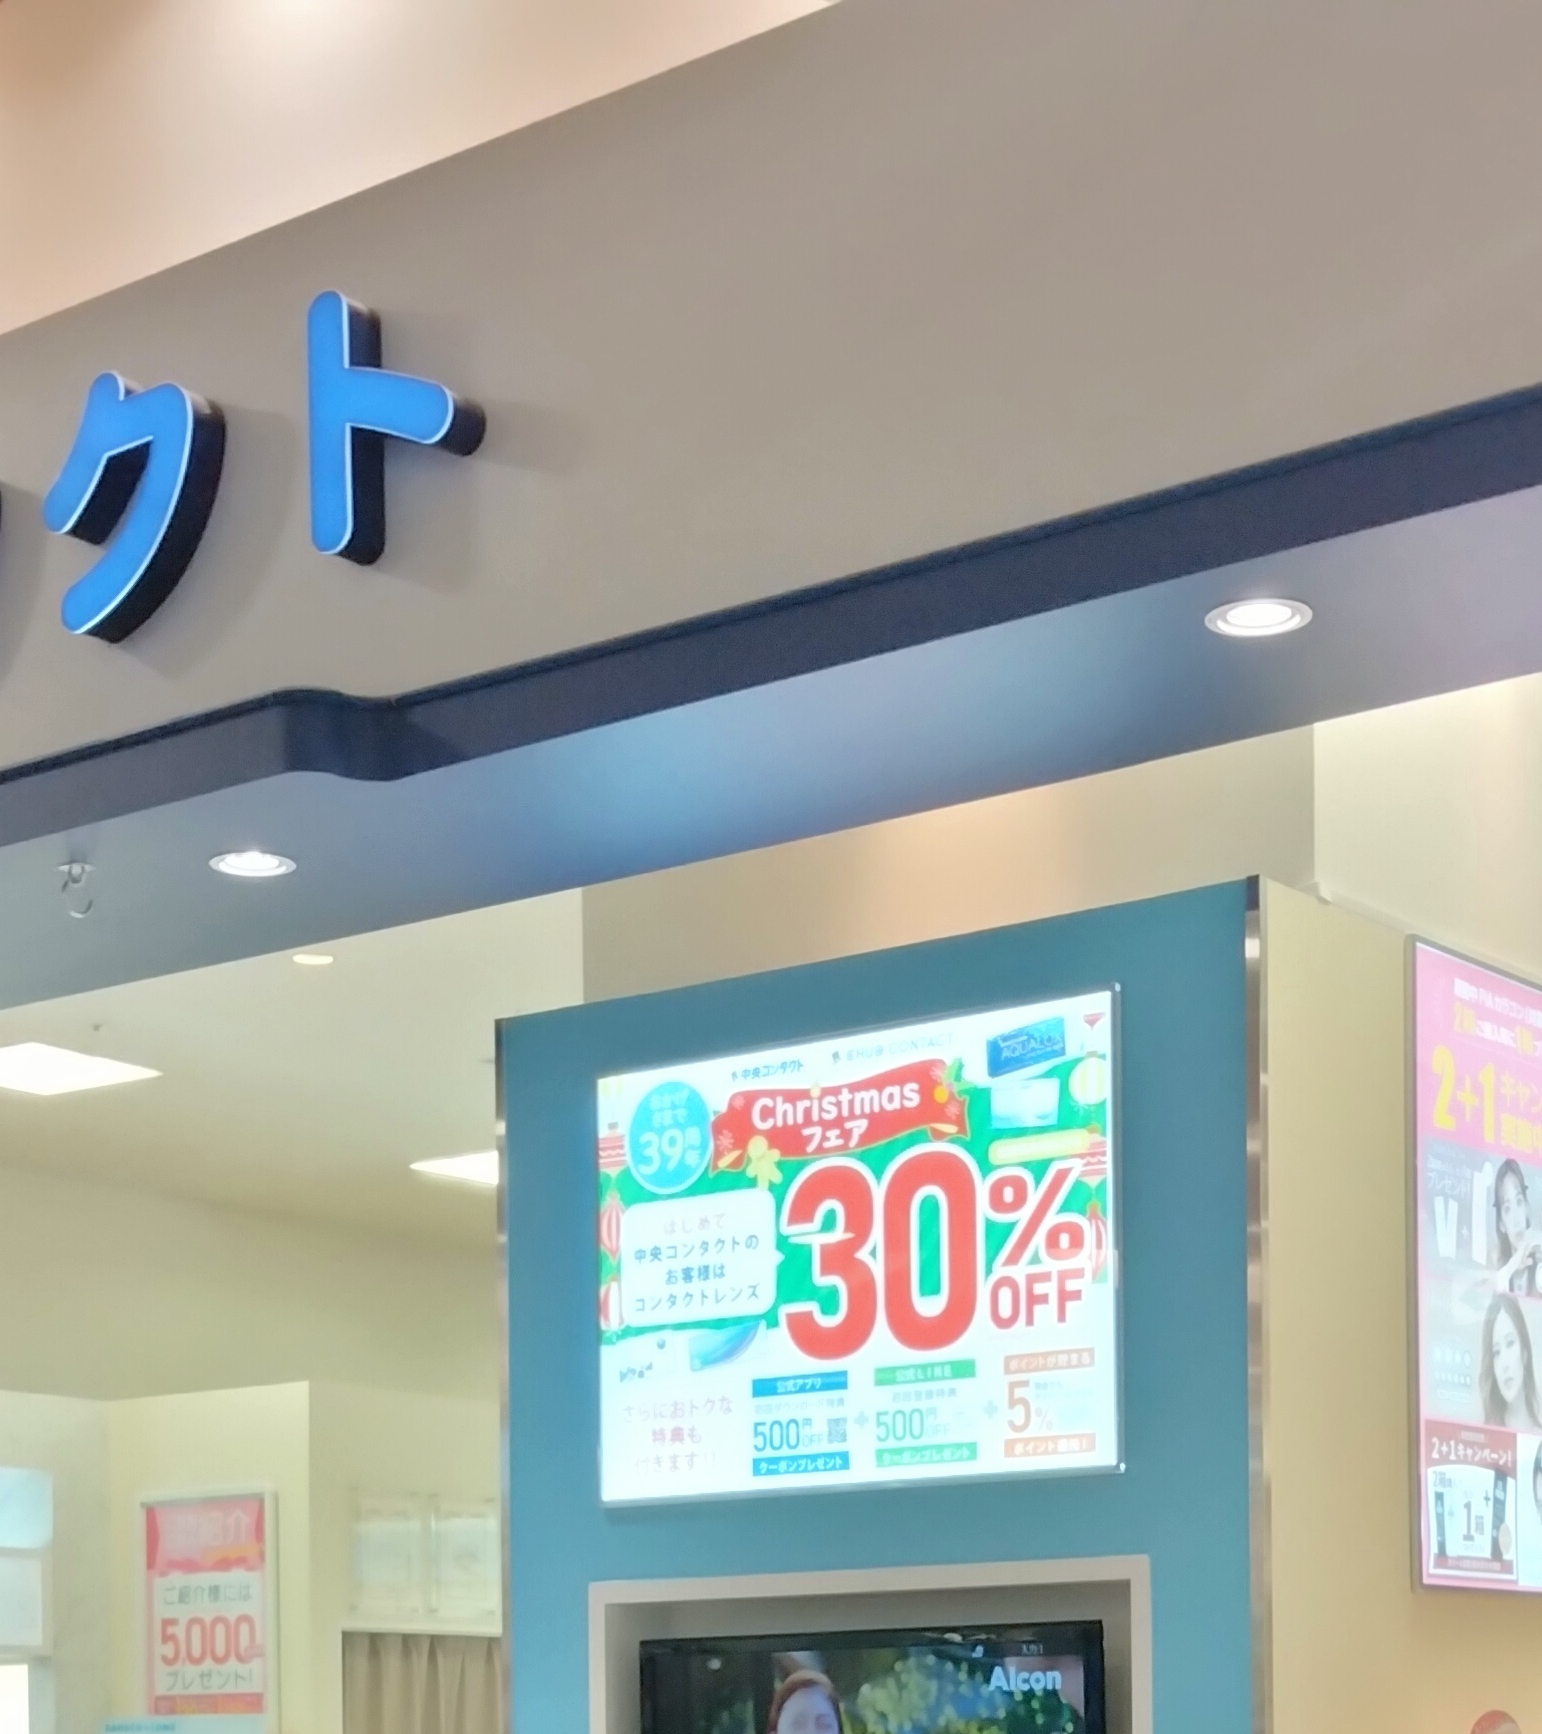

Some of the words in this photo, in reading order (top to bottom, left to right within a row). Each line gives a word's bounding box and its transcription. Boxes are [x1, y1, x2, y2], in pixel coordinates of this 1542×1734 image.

[741, 1059, 803, 1081] 中央コンタクト
[752, 1081, 921, 1131] Christmas
[802, 1118, 869, 1154] フェア
[634, 1233, 760, 1265] 中央コンタクトの
[784, 1150, 1086, 1361] 30%
[665, 1263, 727, 1286] お客様は
[635, 1282, 761, 1313] コンタクトレンズ
[990, 1267, 1085, 1330] OFF
[165, 1668, 253, 1692] プレゼント!
[988, 1665, 1062, 1691] Alcon
